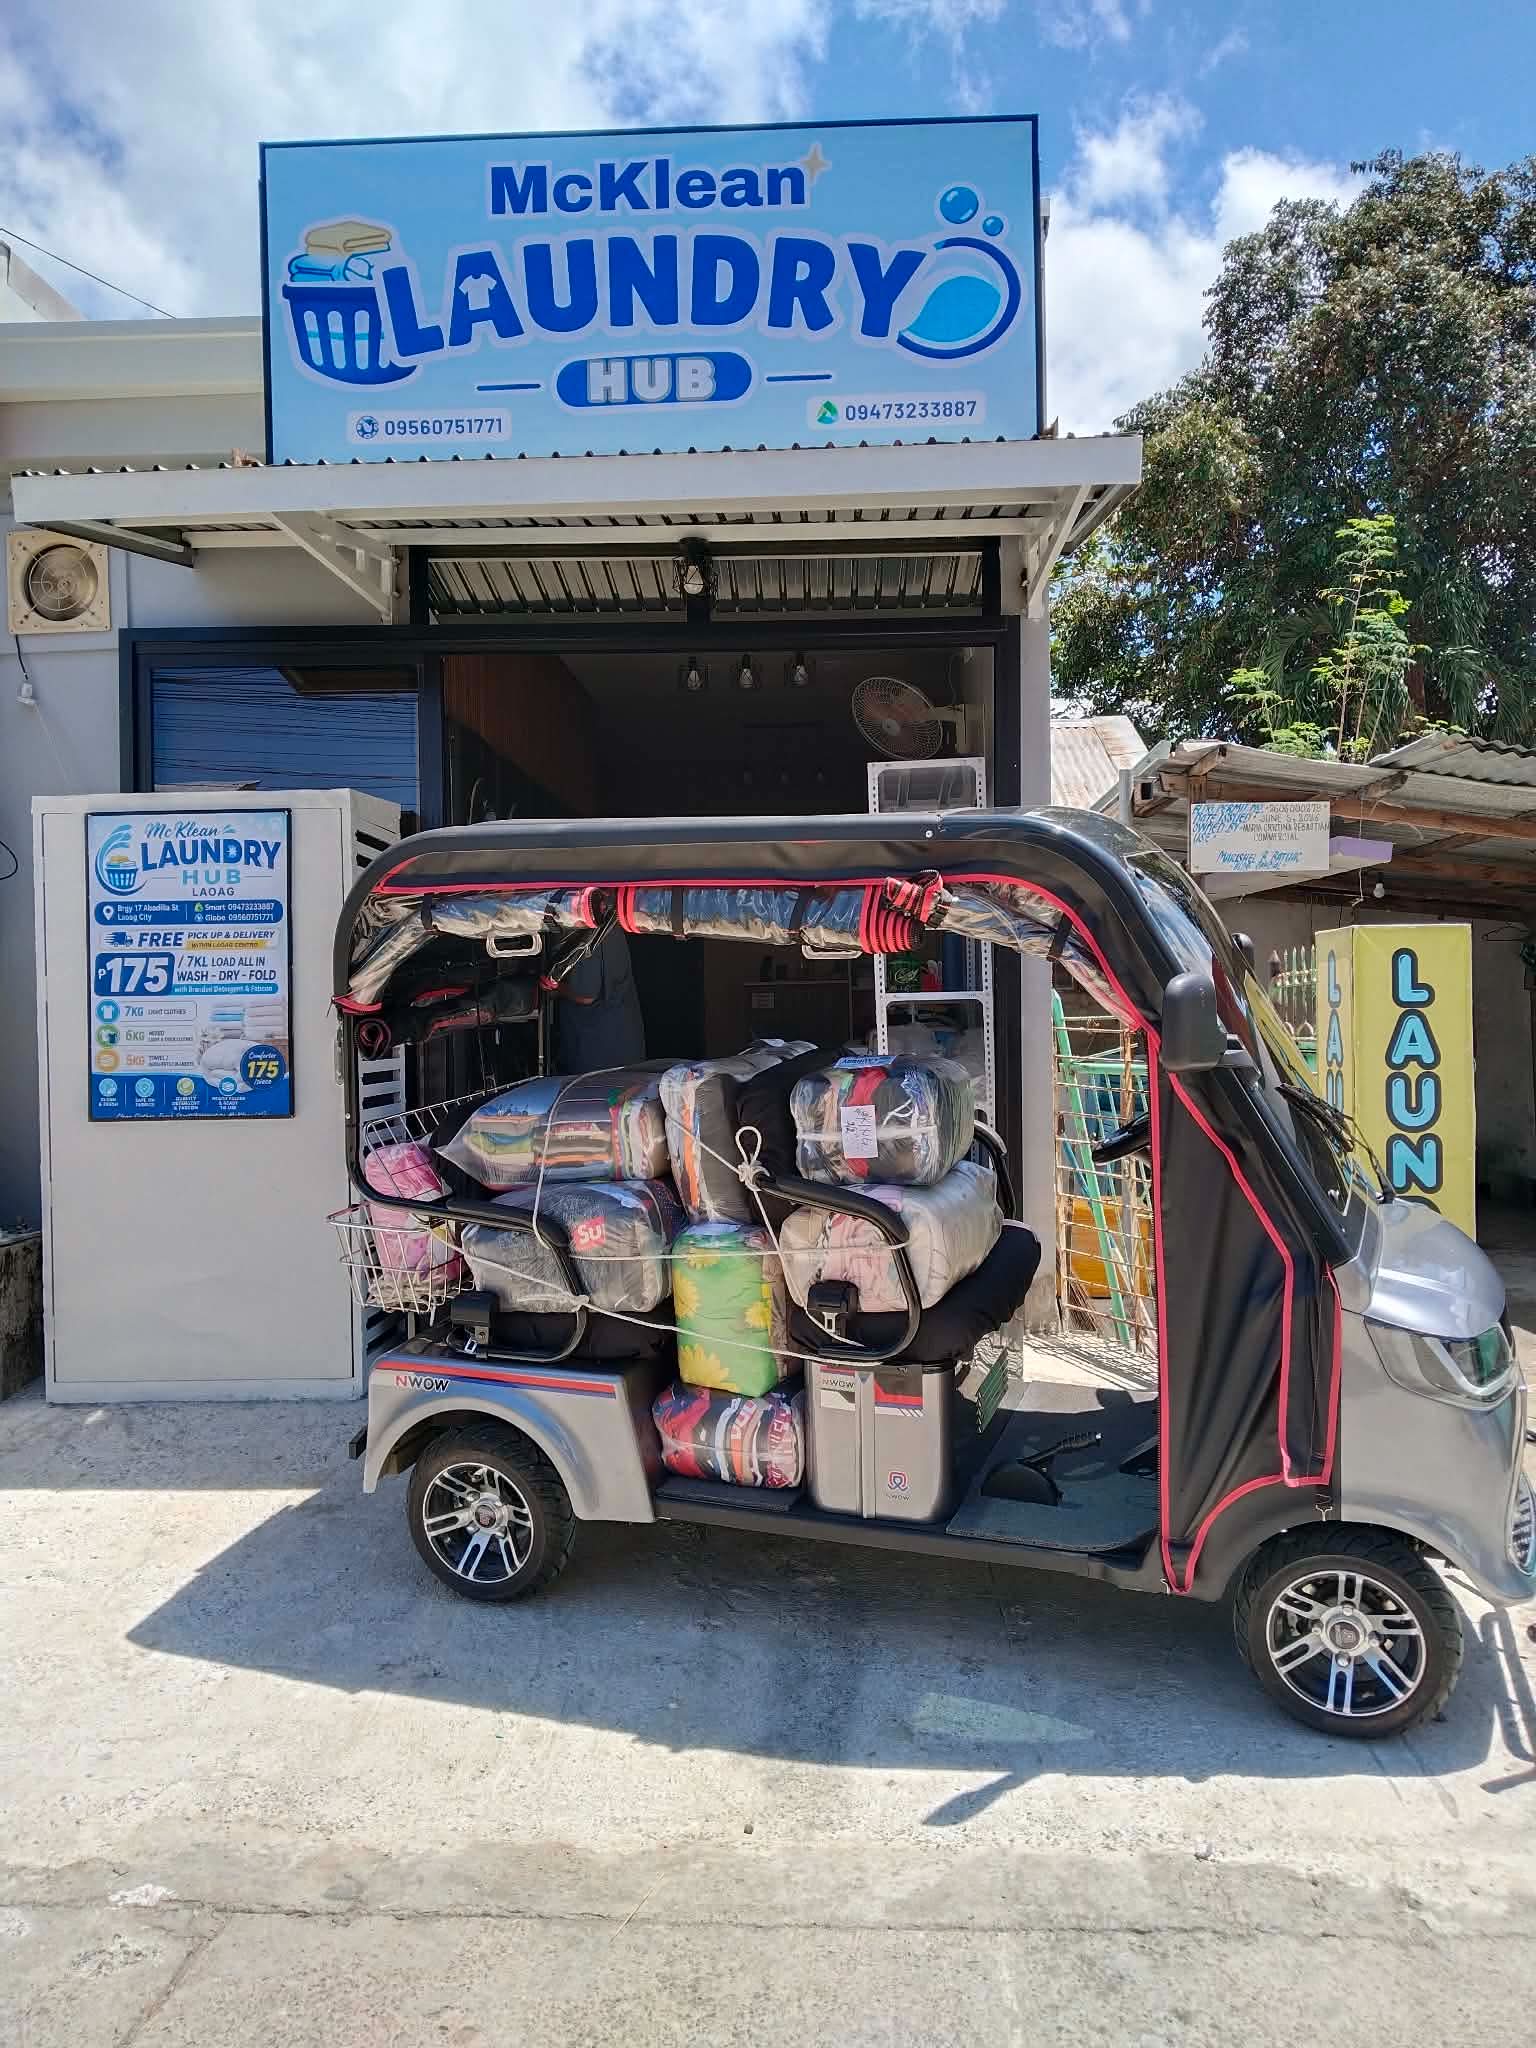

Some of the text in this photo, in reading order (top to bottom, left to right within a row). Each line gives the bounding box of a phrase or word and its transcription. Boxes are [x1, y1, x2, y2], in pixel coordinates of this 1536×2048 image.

[490, 159, 806, 215] McKlean
[381, 234, 927, 358] LAUNDRY
[586, 357, 717, 403] HUB
[845, 401, 977, 422] 09473233887
[384, 416, 503, 437] 09560751771
[141, 839, 281, 871] LAUNDRY
[182, 869, 240, 886] HUB
[192, 887, 235, 897] LAOAG
[135, 904, 143, 912] 17
[205, 903, 226, 911] Smart
[117, 914, 152, 922] Laoag City
[138, 932, 185, 947] FREE
[210, 931, 223, 939] UP
[224, 931, 231, 939] &
[232, 930, 276, 939] DELIVERY
[211, 956, 236, 967] LOAD
[237, 956, 254, 966] ALL
[255, 956, 265, 966] IN
[177, 970, 208, 982] WASH
[218, 970, 239, 981] DRY
[249, 969, 276, 981] FOLD
[174, 985, 187, 993] with
[125, 1006, 144, 1016] 7KG
[126, 1030, 145, 1040] 6KG
[248, 1061, 279, 1079] 175
[1385, 948, 1443, 1213] LAUN
[577, 1222, 606, 1245] Su
[395, 1375, 449, 1391] NWOW
